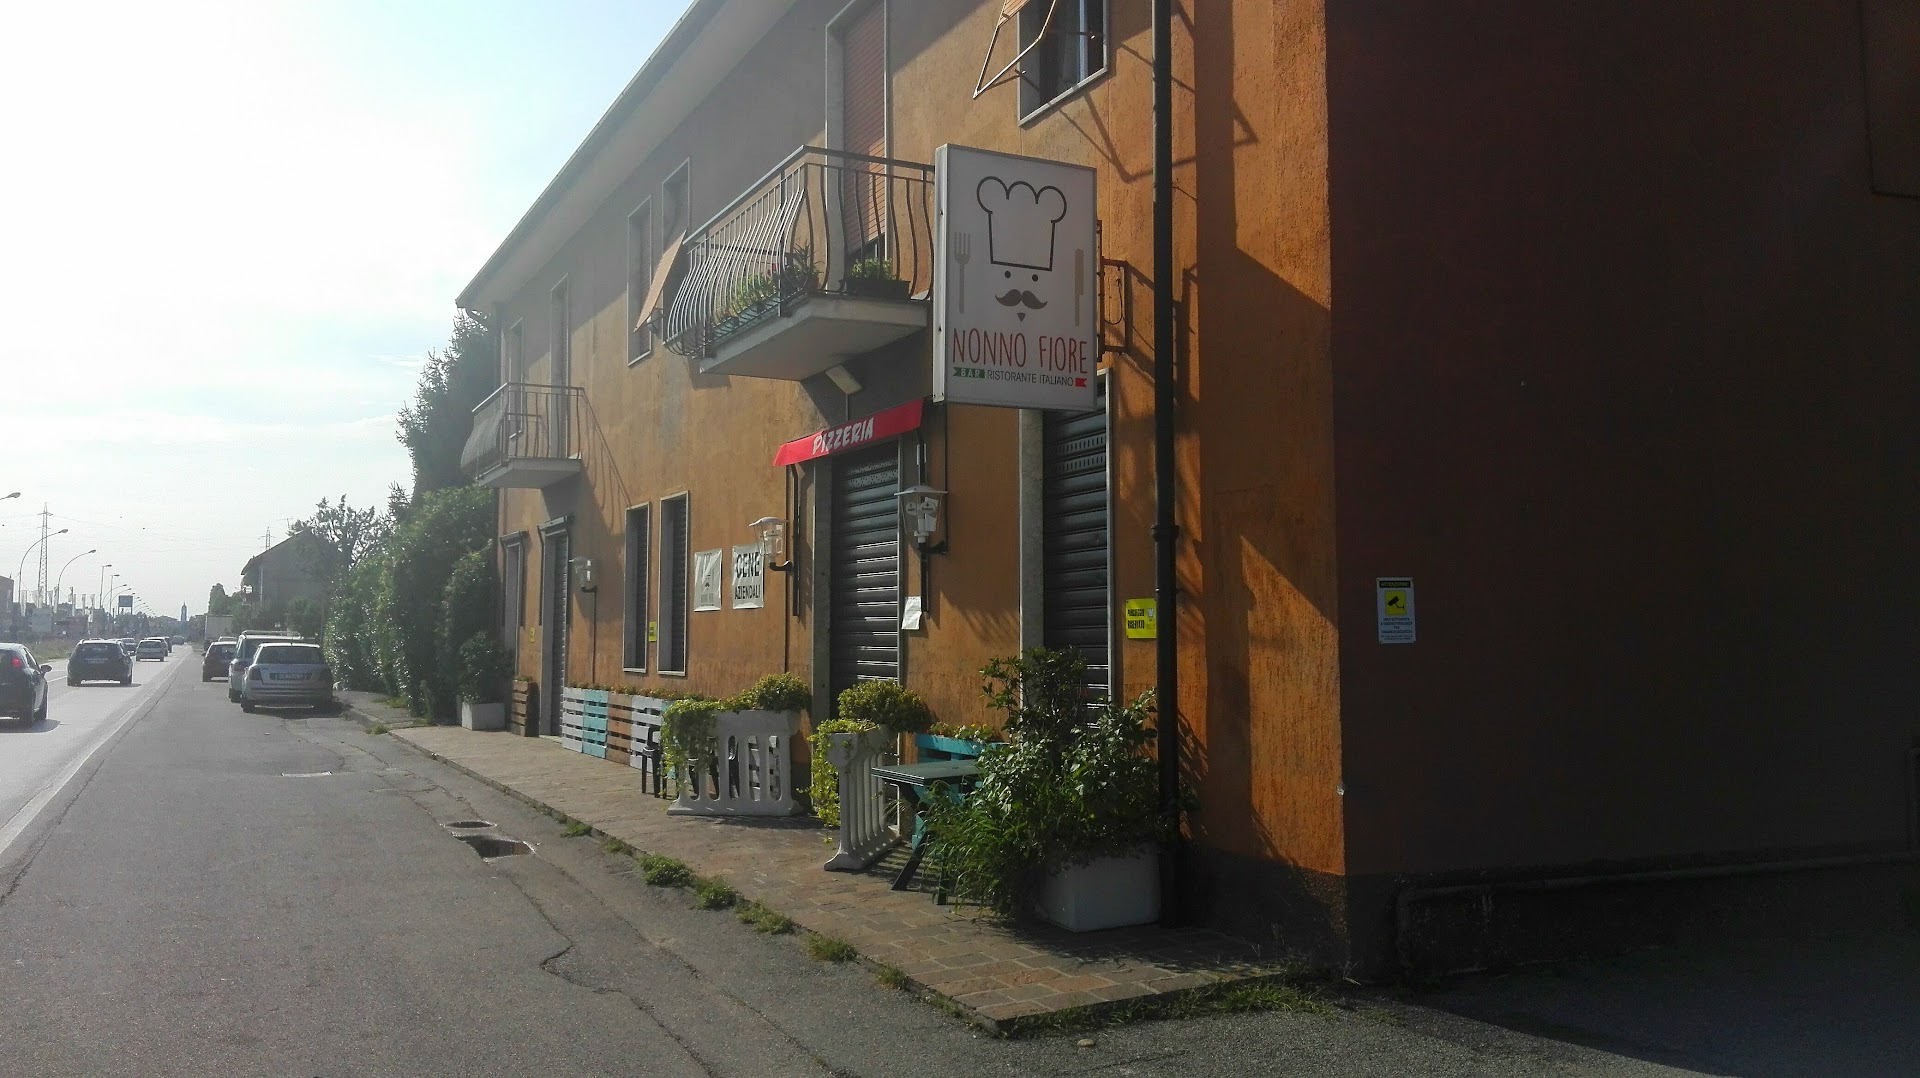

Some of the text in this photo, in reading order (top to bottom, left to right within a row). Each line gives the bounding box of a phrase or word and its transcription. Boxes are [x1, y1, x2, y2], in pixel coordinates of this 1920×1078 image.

[953, 327, 1088, 374] NONNO FIORE
[960, 368, 1074, 386] BAR RISTORANTE ITALIANO
[812, 417, 875, 455] PIZZERIA
[736, 551, 760, 579] CENE
[734, 584, 761, 600] AZIENDALI
